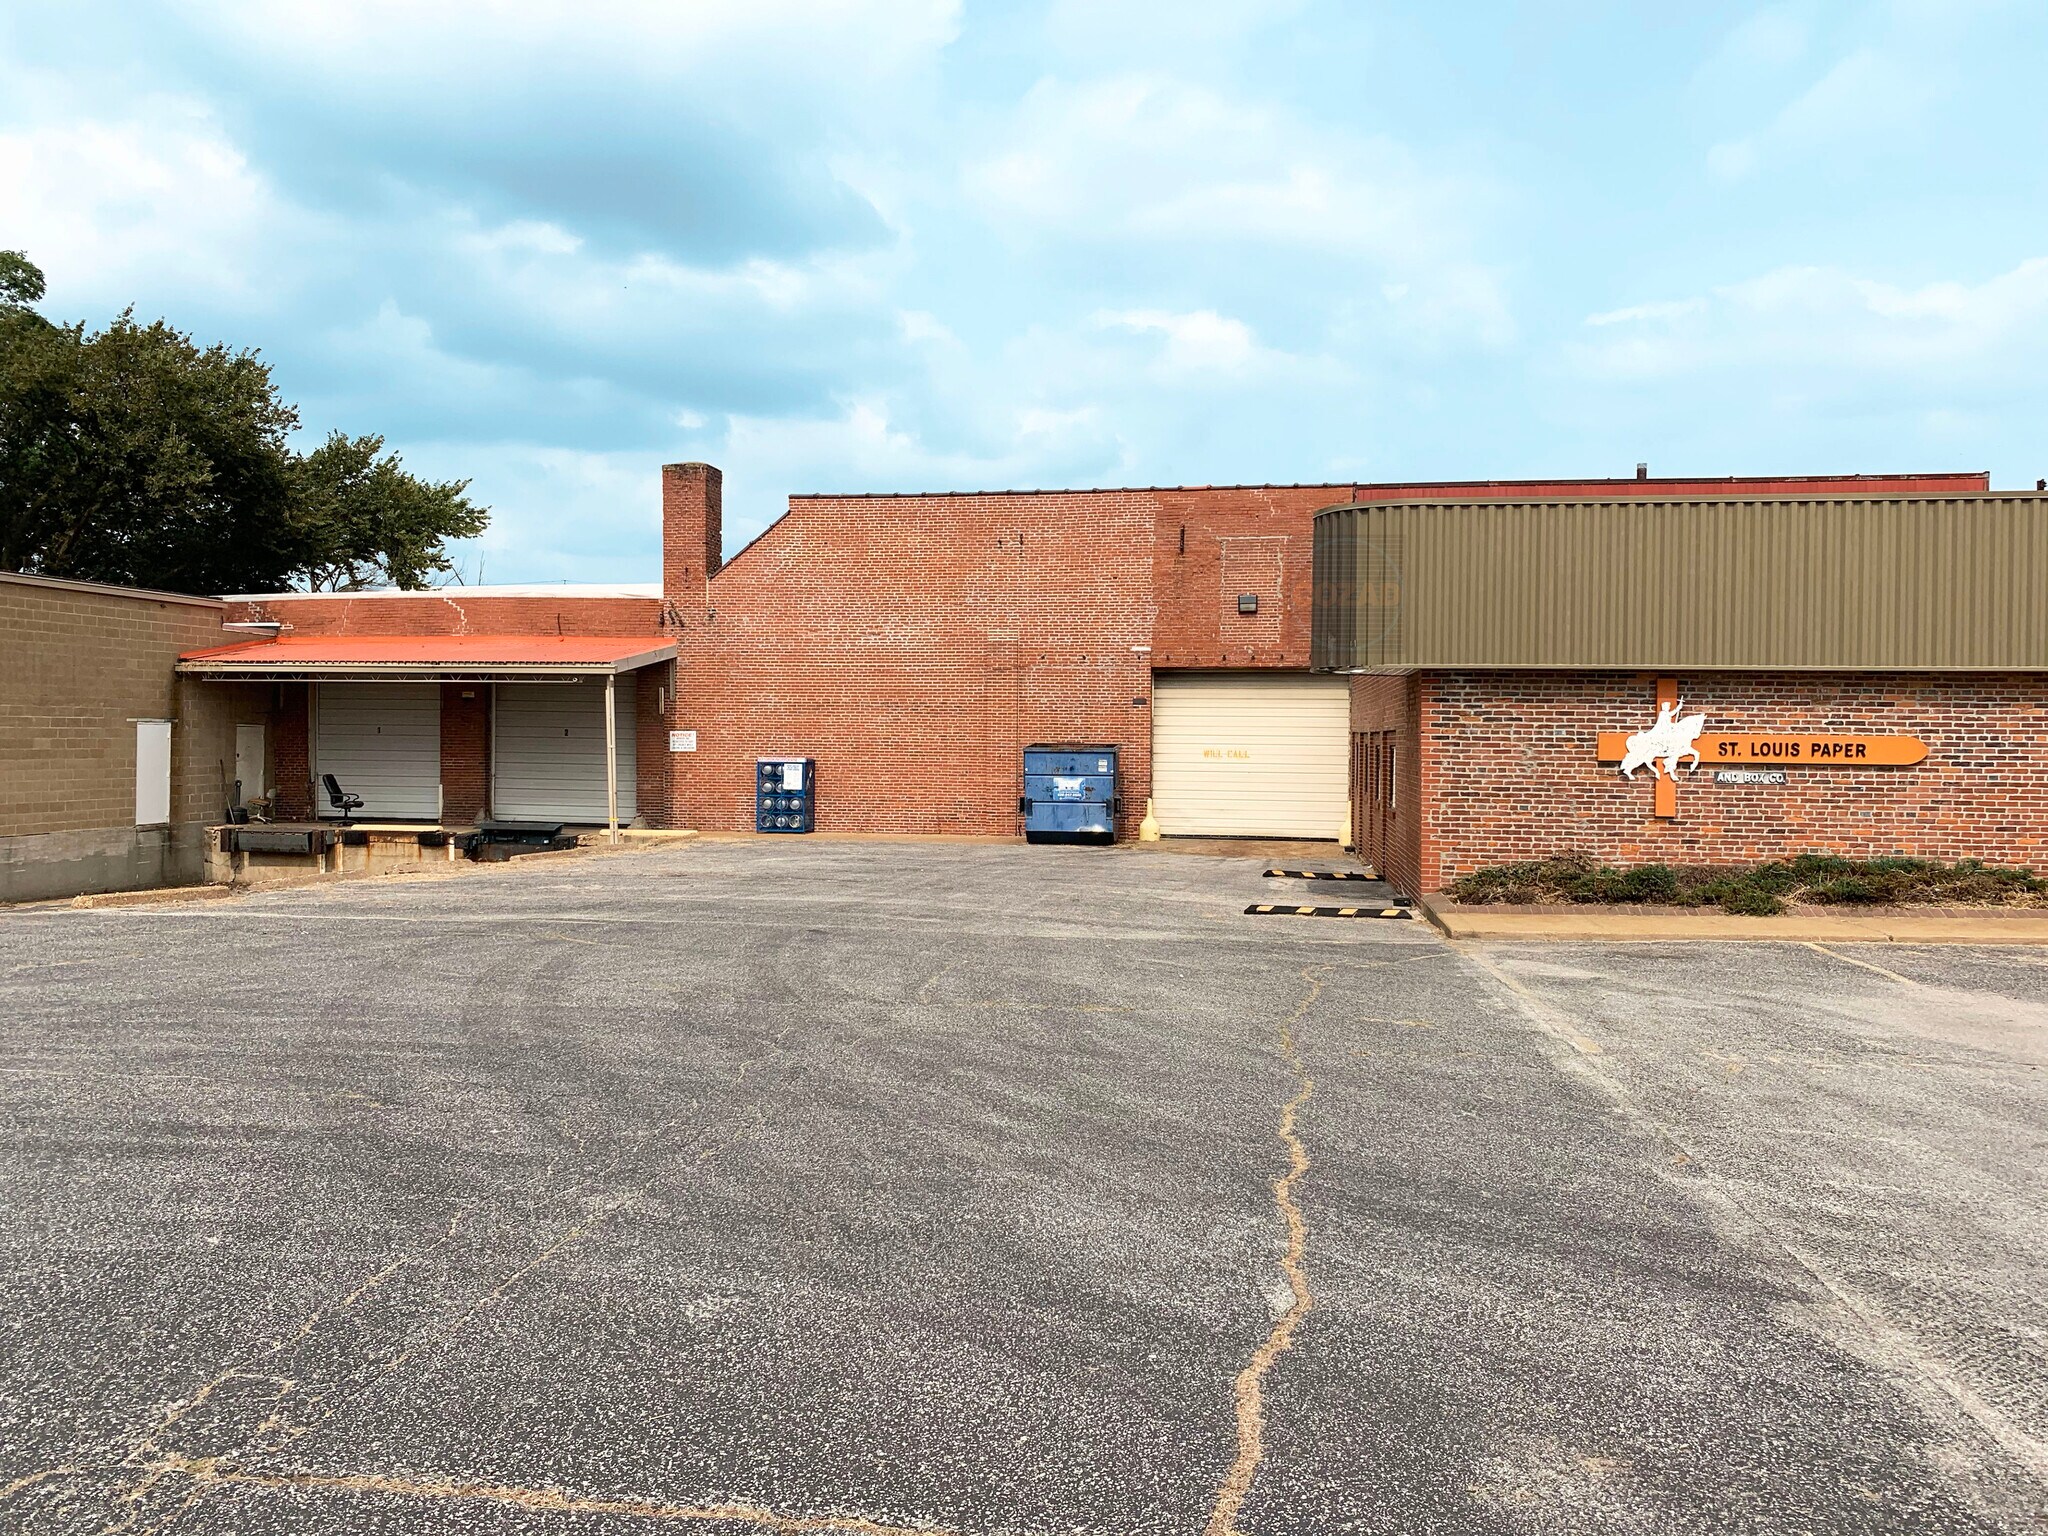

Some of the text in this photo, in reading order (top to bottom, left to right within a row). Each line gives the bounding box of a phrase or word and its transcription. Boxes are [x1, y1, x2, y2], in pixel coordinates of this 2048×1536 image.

[564, 728, 569, 736] 2
[1203, 749, 1250, 759] WILL CALL
[1718, 742, 1867, 758] ST. LOUIS PAPER
[1716, 772, 1787, 784] AND BOX CO.
